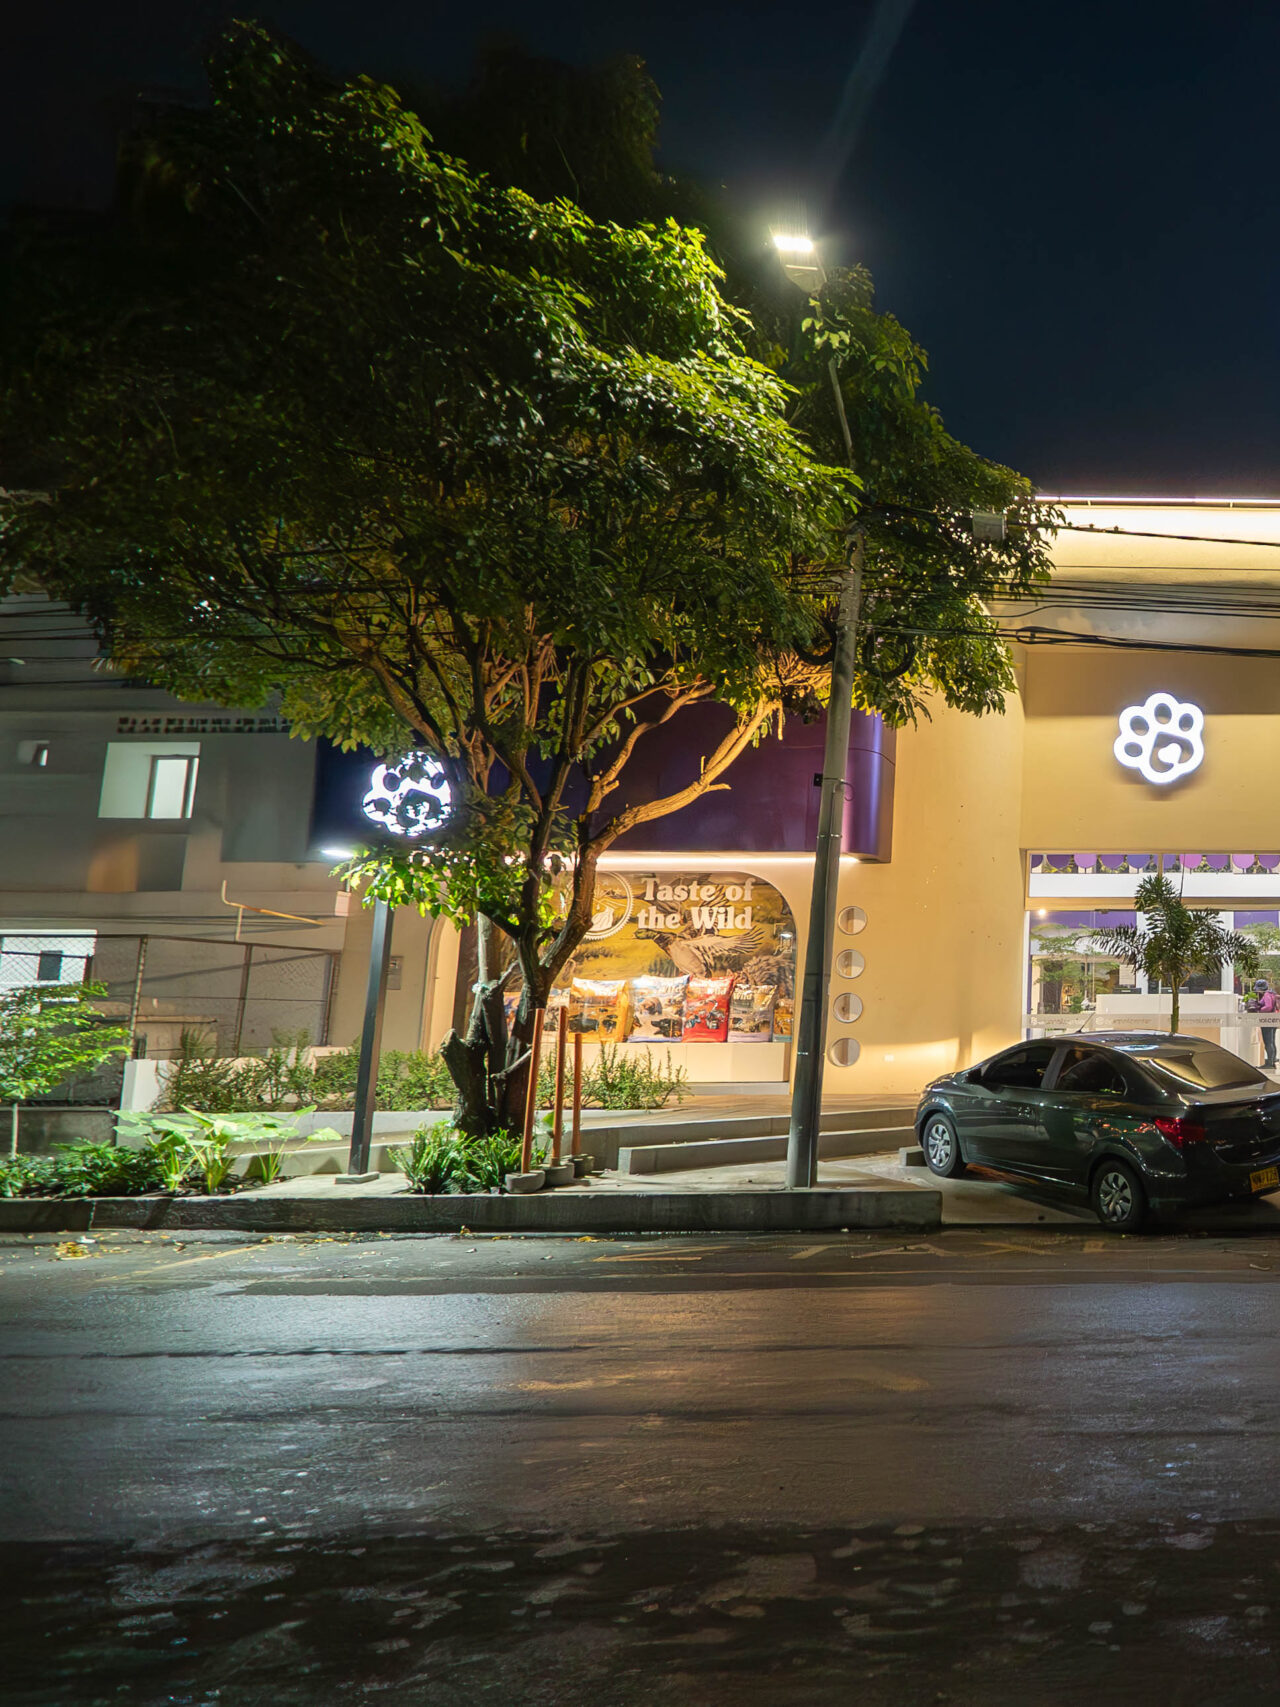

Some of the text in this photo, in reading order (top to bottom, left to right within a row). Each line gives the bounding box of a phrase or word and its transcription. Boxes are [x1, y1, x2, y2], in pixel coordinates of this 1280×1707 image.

[640, 877, 756, 901] Taste of
[636, 906, 753, 930] the Wild
